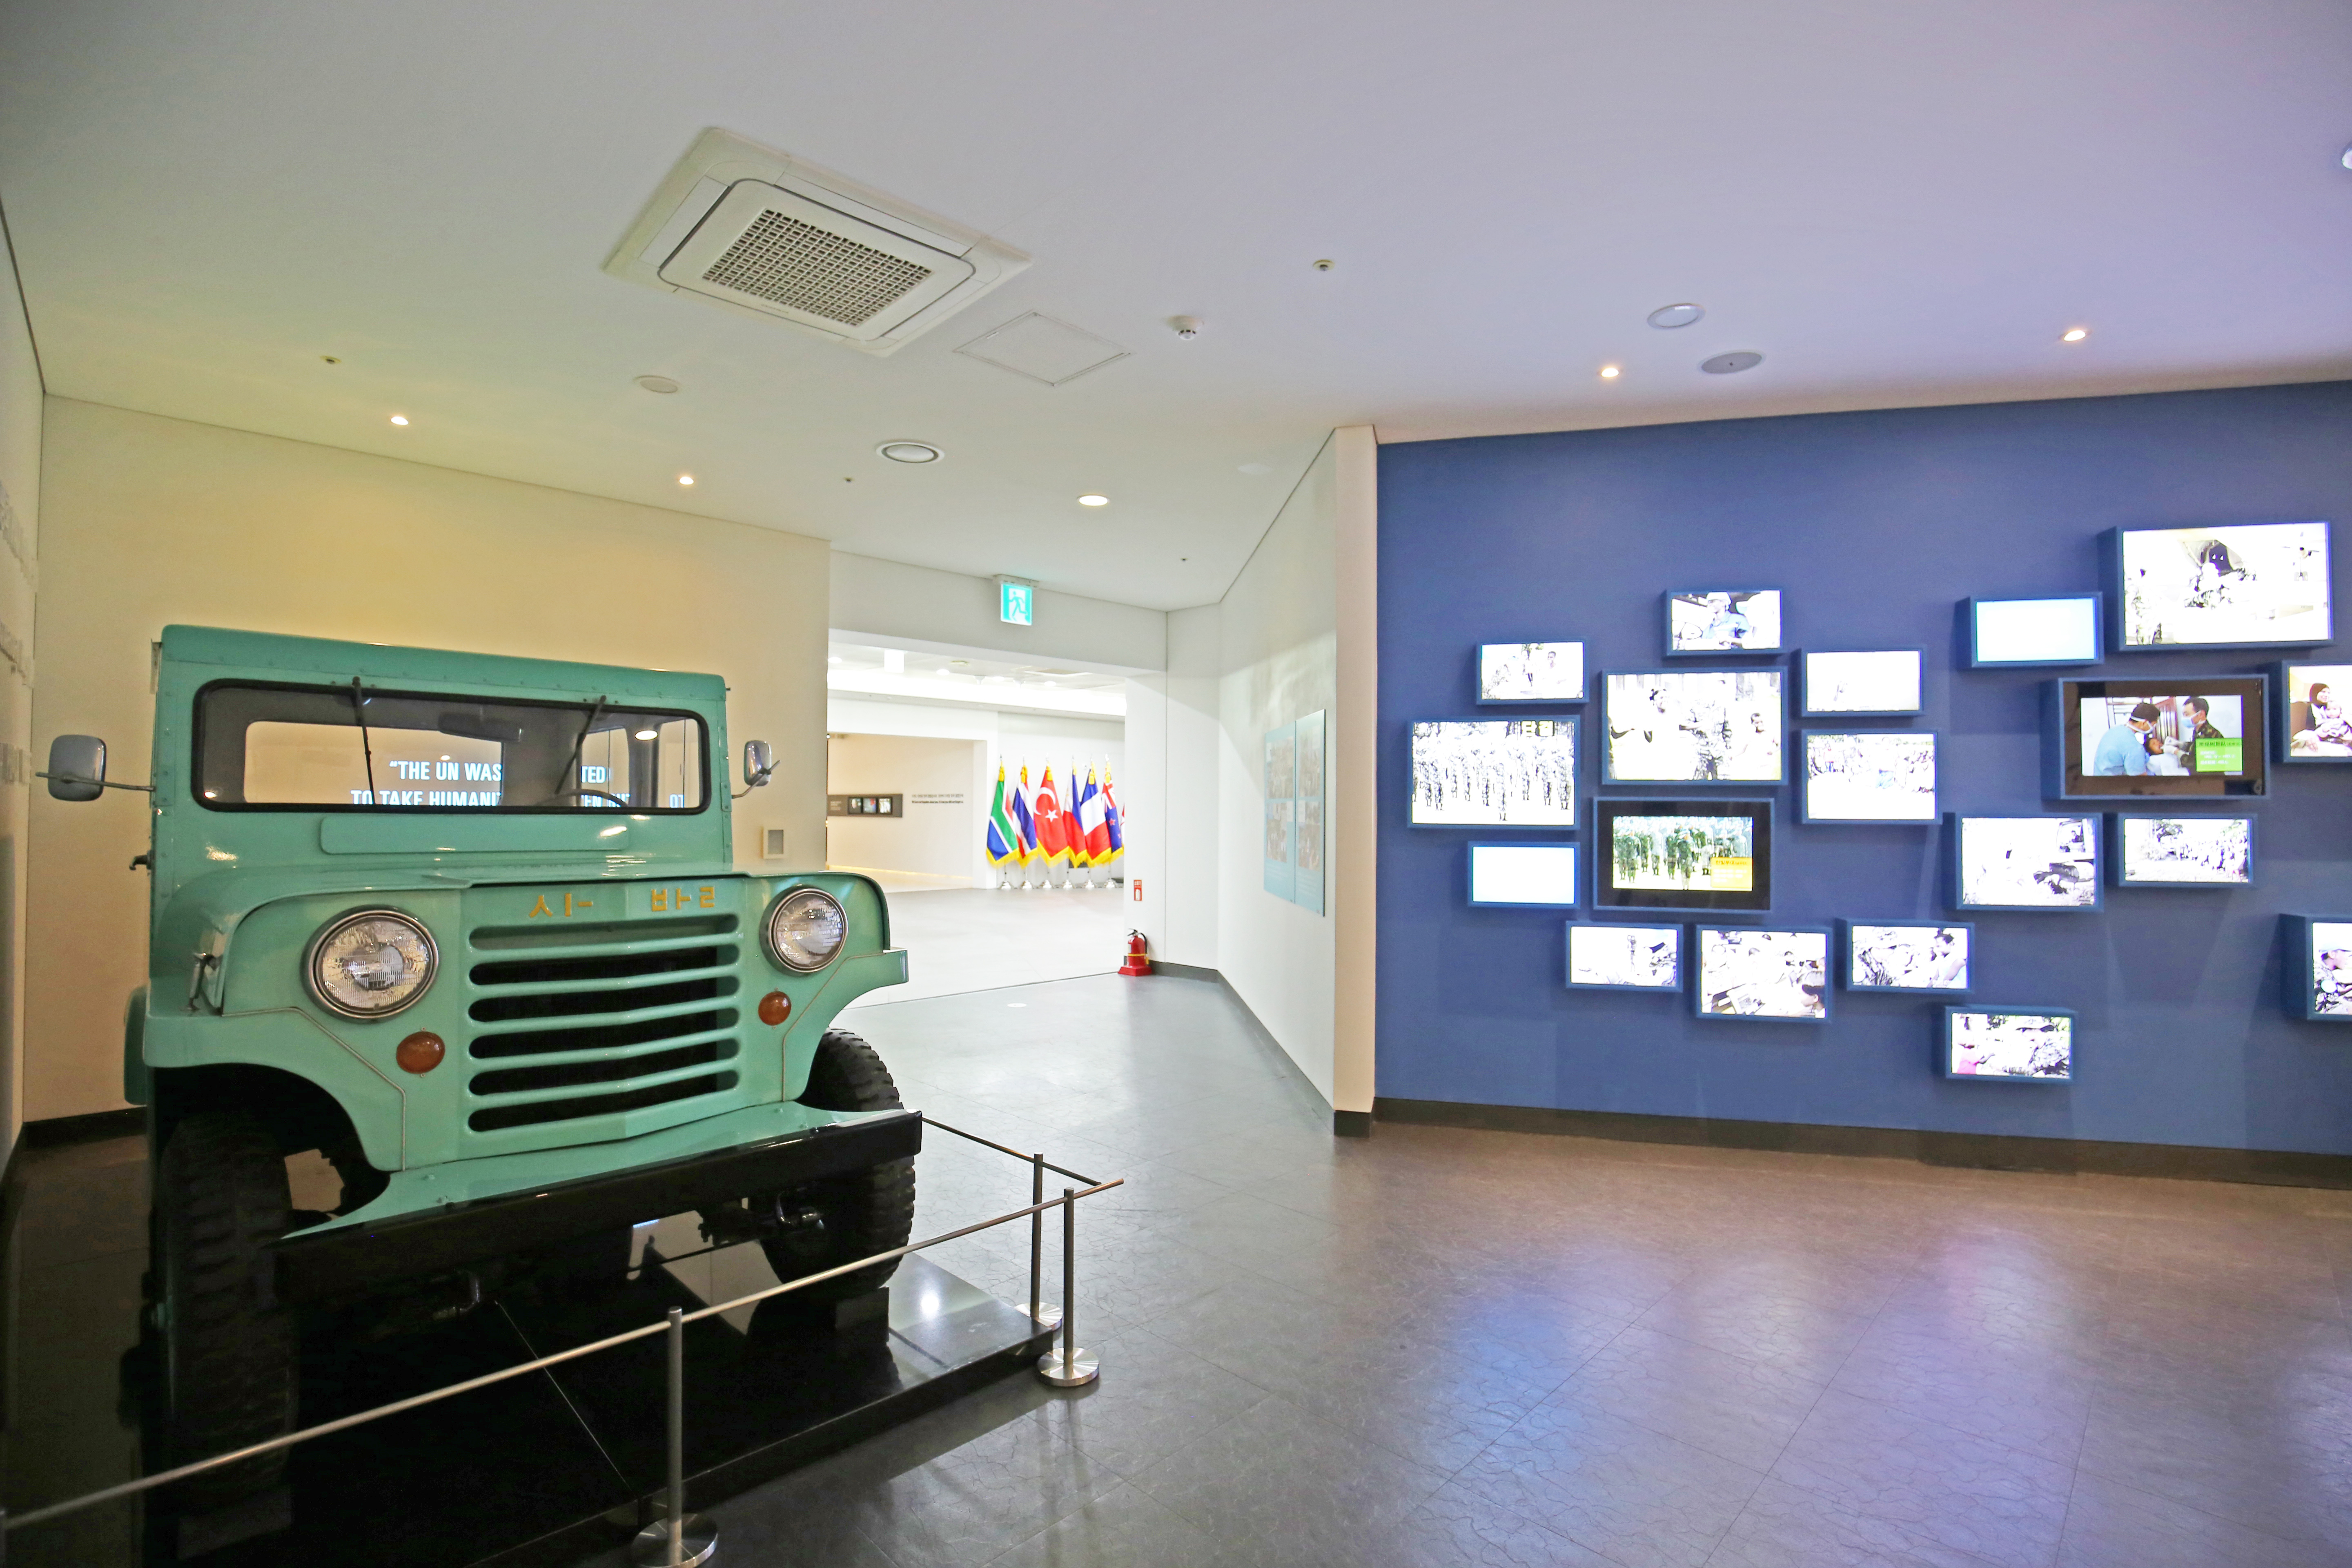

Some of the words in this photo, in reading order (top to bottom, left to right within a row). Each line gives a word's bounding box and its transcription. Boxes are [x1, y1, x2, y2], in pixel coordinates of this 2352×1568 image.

[389, 760, 431, 780] “THE
[435, 762, 460, 781] UN
[464, 762, 502, 782] WAS
[429, 791, 501, 806] HUMANI
